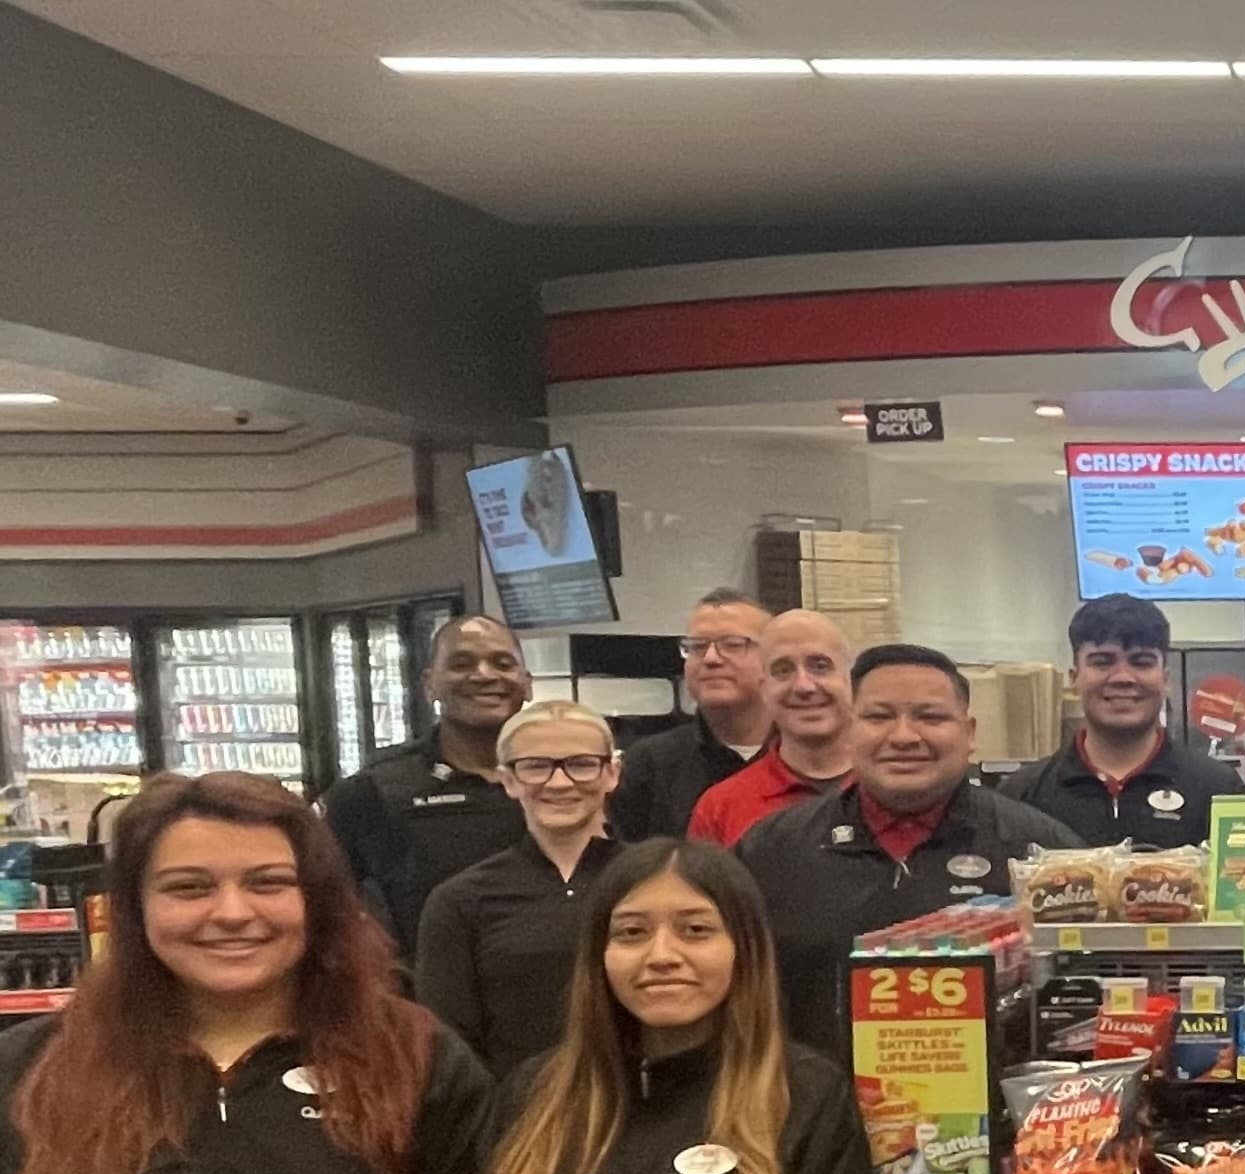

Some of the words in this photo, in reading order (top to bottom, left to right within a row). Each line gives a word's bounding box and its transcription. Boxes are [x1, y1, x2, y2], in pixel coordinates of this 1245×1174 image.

[878, 408, 928, 422] ORDER
[876, 422, 910, 436] PICK
[912, 421, 933, 435] UP
[1076, 453, 1162, 472] CRISPY
[869, 967, 899, 999] 2
[908, 967, 967, 1006] $6
[1176, 1016, 1228, 1032] Advil
[878, 1027, 963, 1038] STARBURST
[877, 1041, 949, 1050] SKITTLES
[880, 1052, 906, 1062] LIFE
[911, 1051, 961, 1061] SAVERS
[875, 1064, 932, 1074] GUMMIES
[935, 1063, 968, 1073] BAGS
[1030, 1098, 1101, 1124] FLAMING
